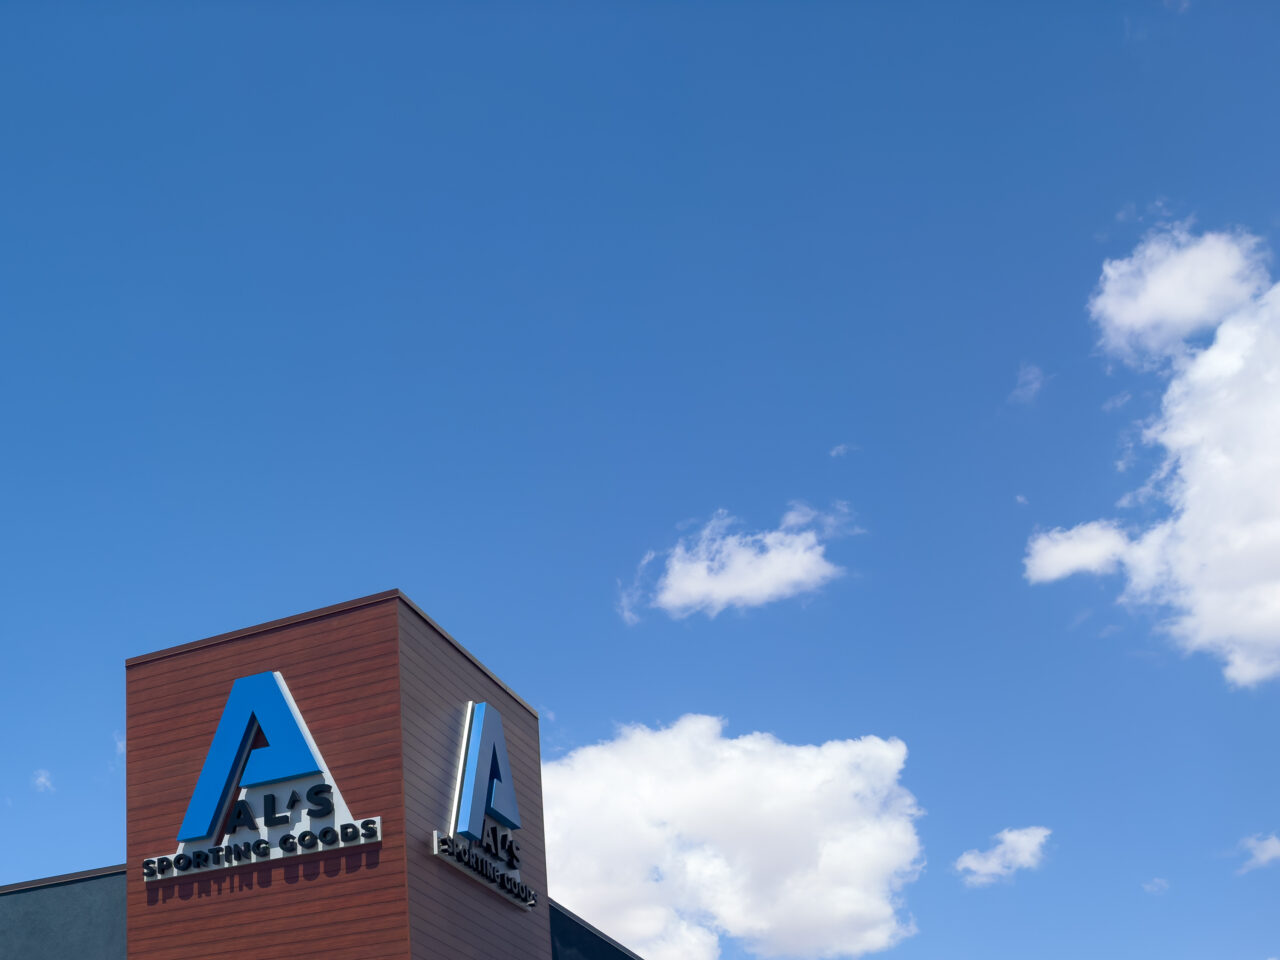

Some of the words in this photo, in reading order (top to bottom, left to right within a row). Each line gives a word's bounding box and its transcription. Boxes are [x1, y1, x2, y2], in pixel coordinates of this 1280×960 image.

[177, 671, 323, 841] A
[457, 702, 521, 841] A
[224, 783, 335, 835] AL'S
[142, 838, 271, 878] SPORTING
[278, 818, 378, 853] GOODS
[440, 835, 501, 884] SPORTING
[502, 873, 538, 907] GOODS
